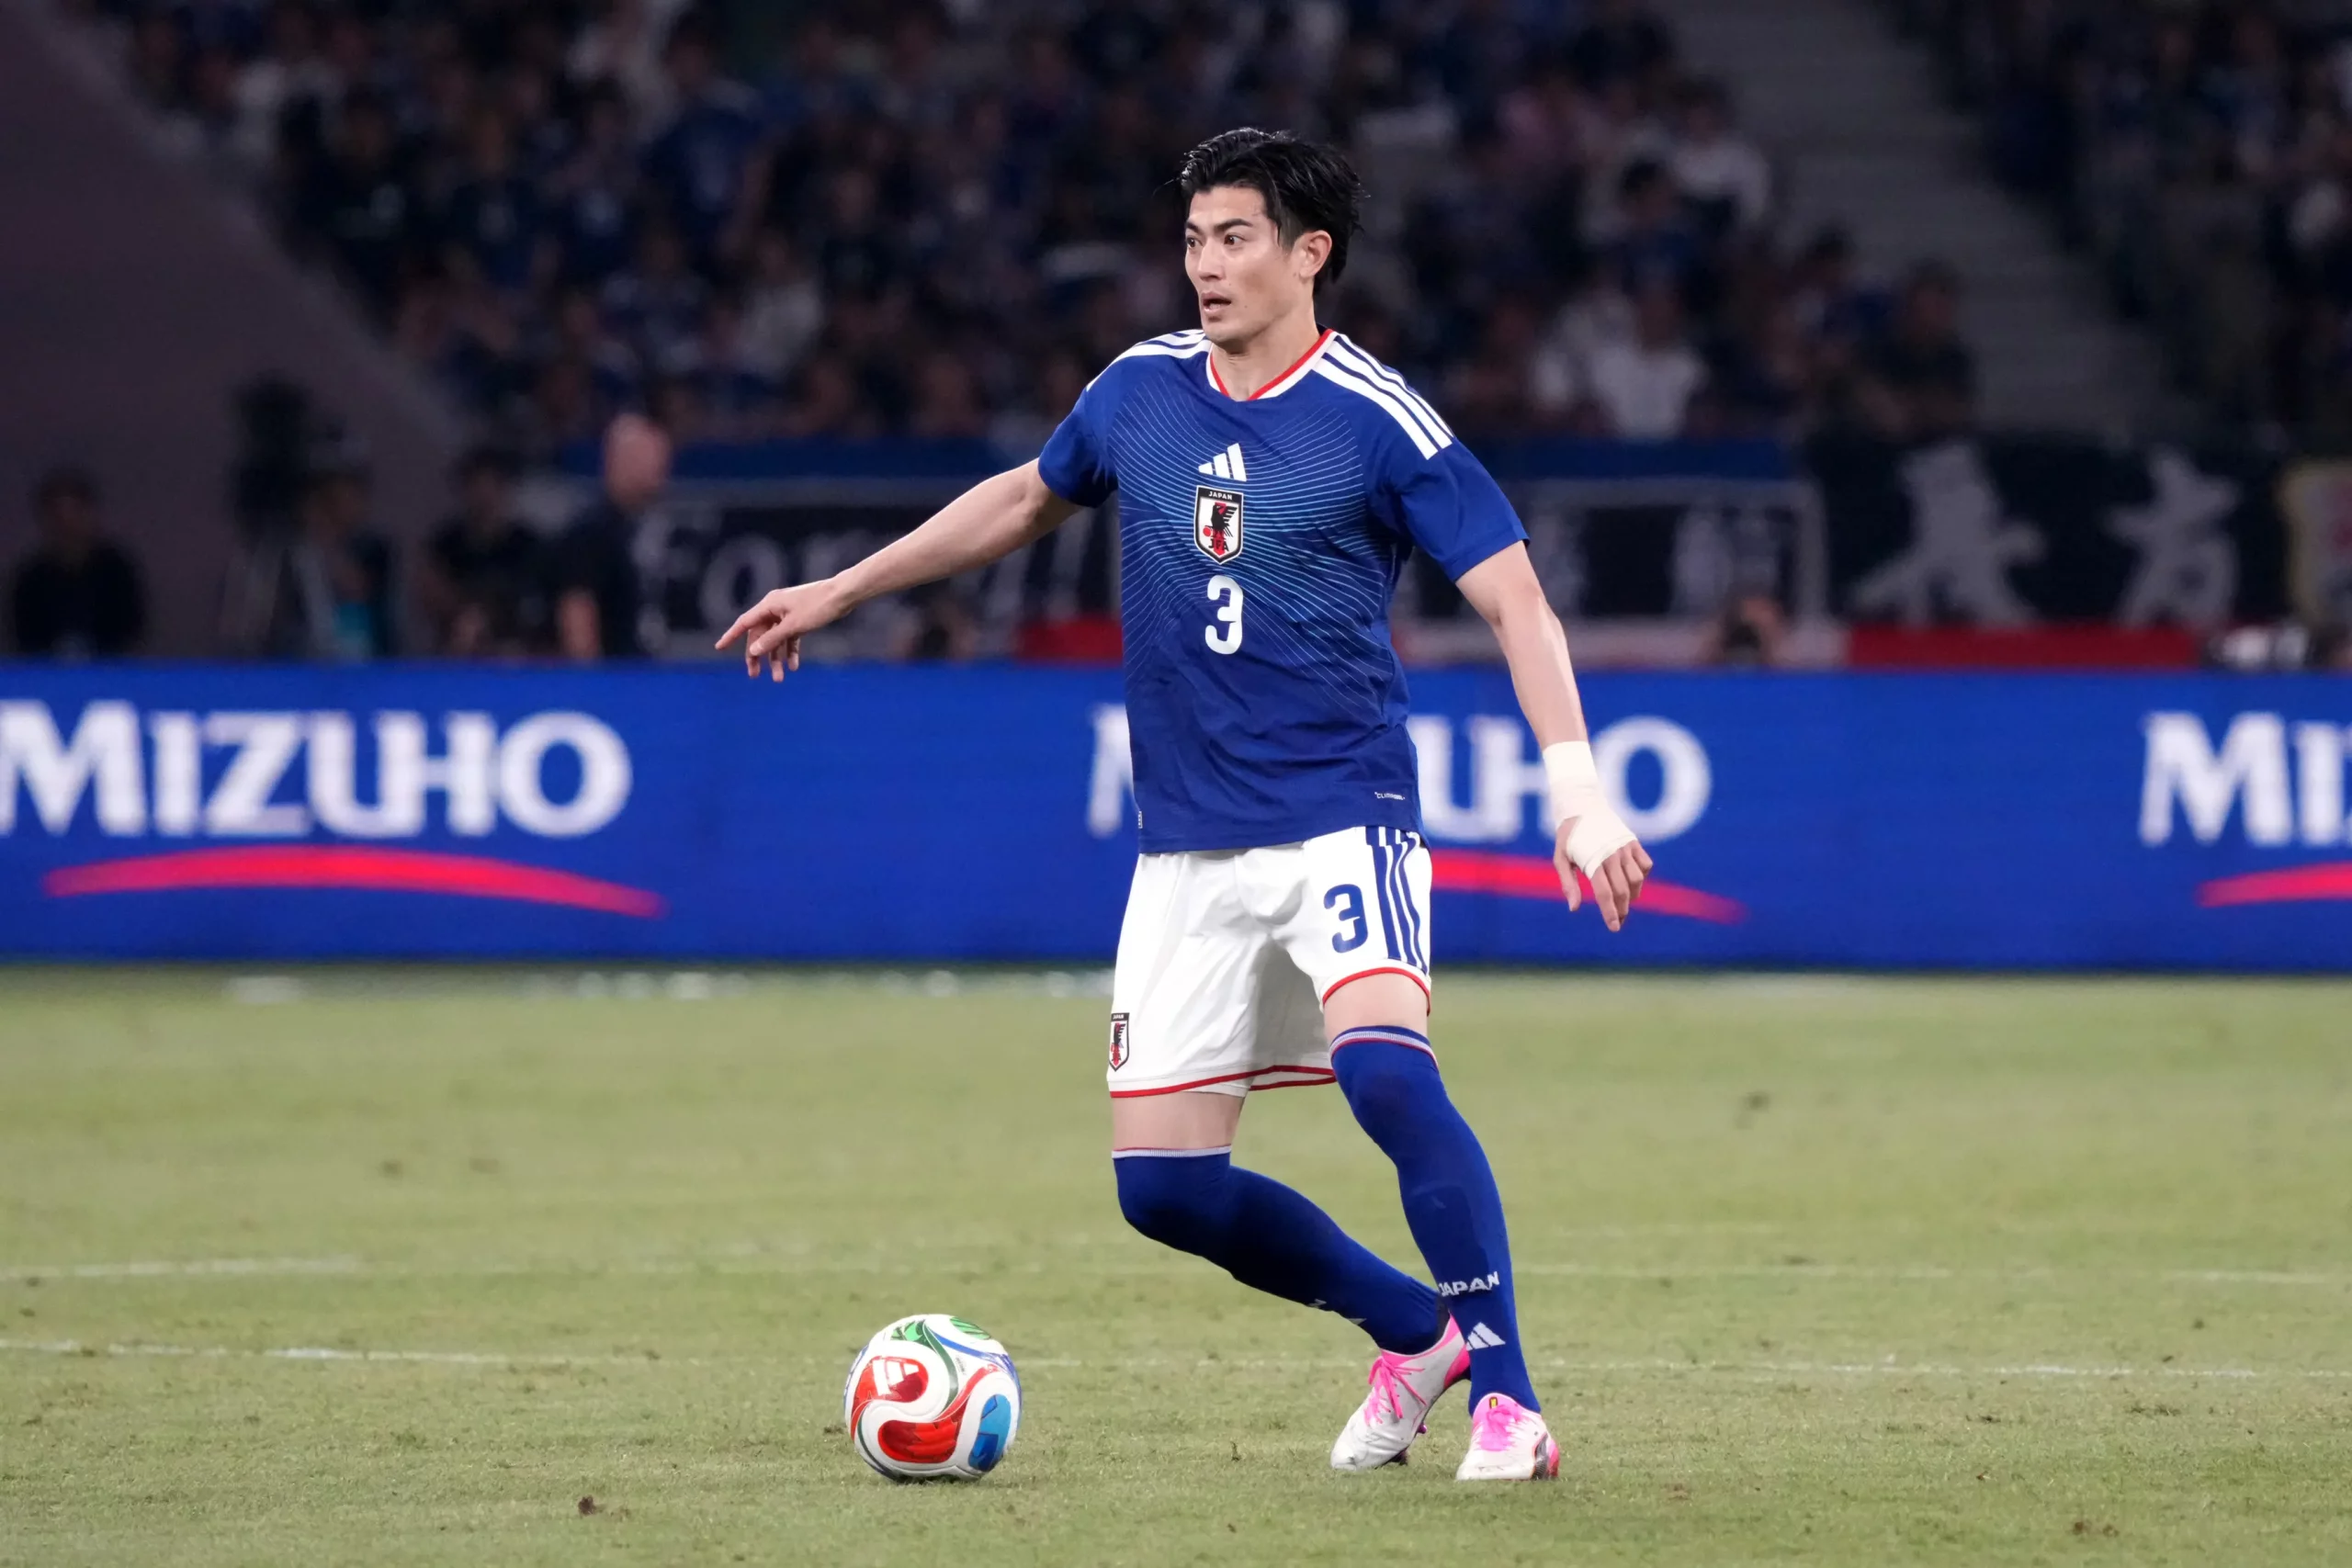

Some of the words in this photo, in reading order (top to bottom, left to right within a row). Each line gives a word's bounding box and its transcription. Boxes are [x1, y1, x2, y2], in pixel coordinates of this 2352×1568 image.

[1208, 491, 1233, 501] JAPAN
[1204, 575, 1244, 654] 3
[0, 698, 634, 838] MIZUHO
[2137, 708, 2352, 848] MI
[1324, 884, 1369, 953] 3
[1438, 1270, 1500, 1297] JAPAN
